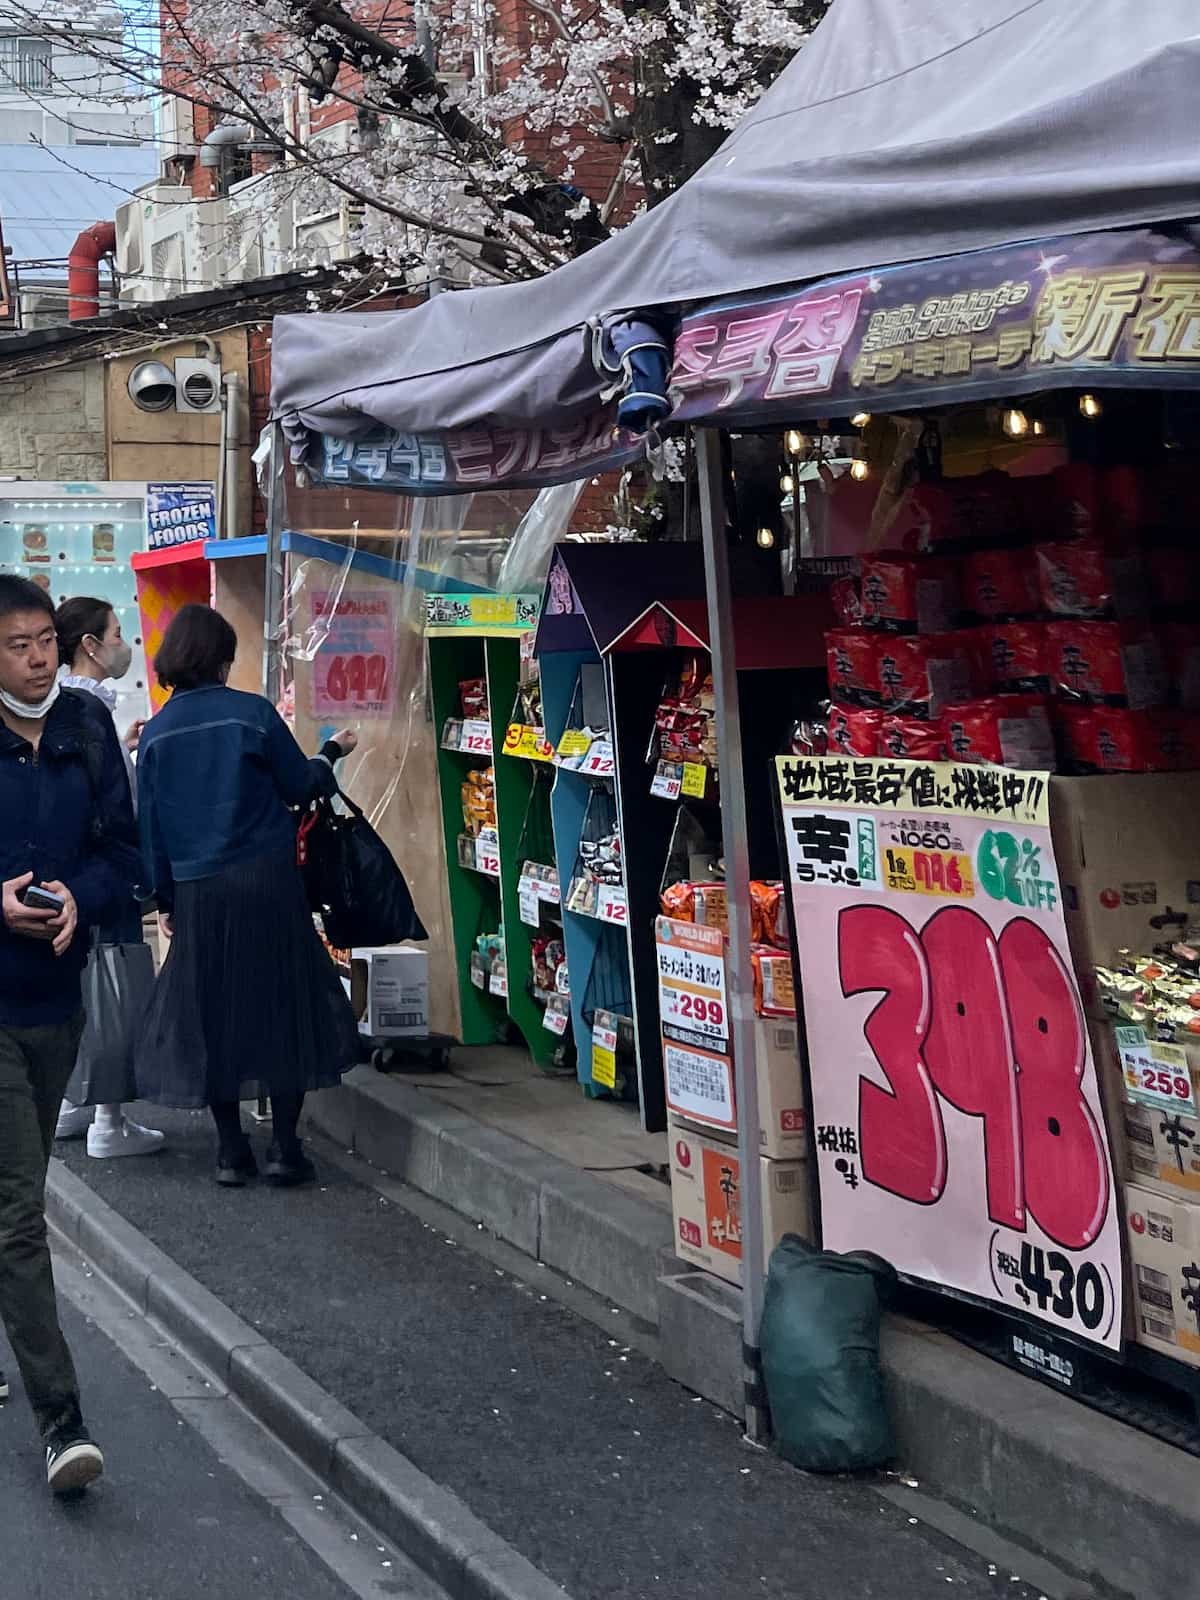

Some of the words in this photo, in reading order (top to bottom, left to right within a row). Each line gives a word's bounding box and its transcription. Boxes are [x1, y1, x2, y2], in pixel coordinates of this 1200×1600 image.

[1031, 270, 1200, 364] 新宿
[150, 502, 212, 528] FROZEN
[153, 521, 210, 547] FOODS
[590, 756, 615, 772] 12
[792, 814, 851, 865] 辛
[796, 862, 861, 887] ラーメン
[679, 993, 724, 1026] 299
[703, 1023, 722, 1036] 323
[838, 904, 1108, 1250] 398
[1142, 1068, 1191, 1099] 259
[817, 1125, 858, 1154] 税抜
[1020, 1241, 1105, 1330] 430
